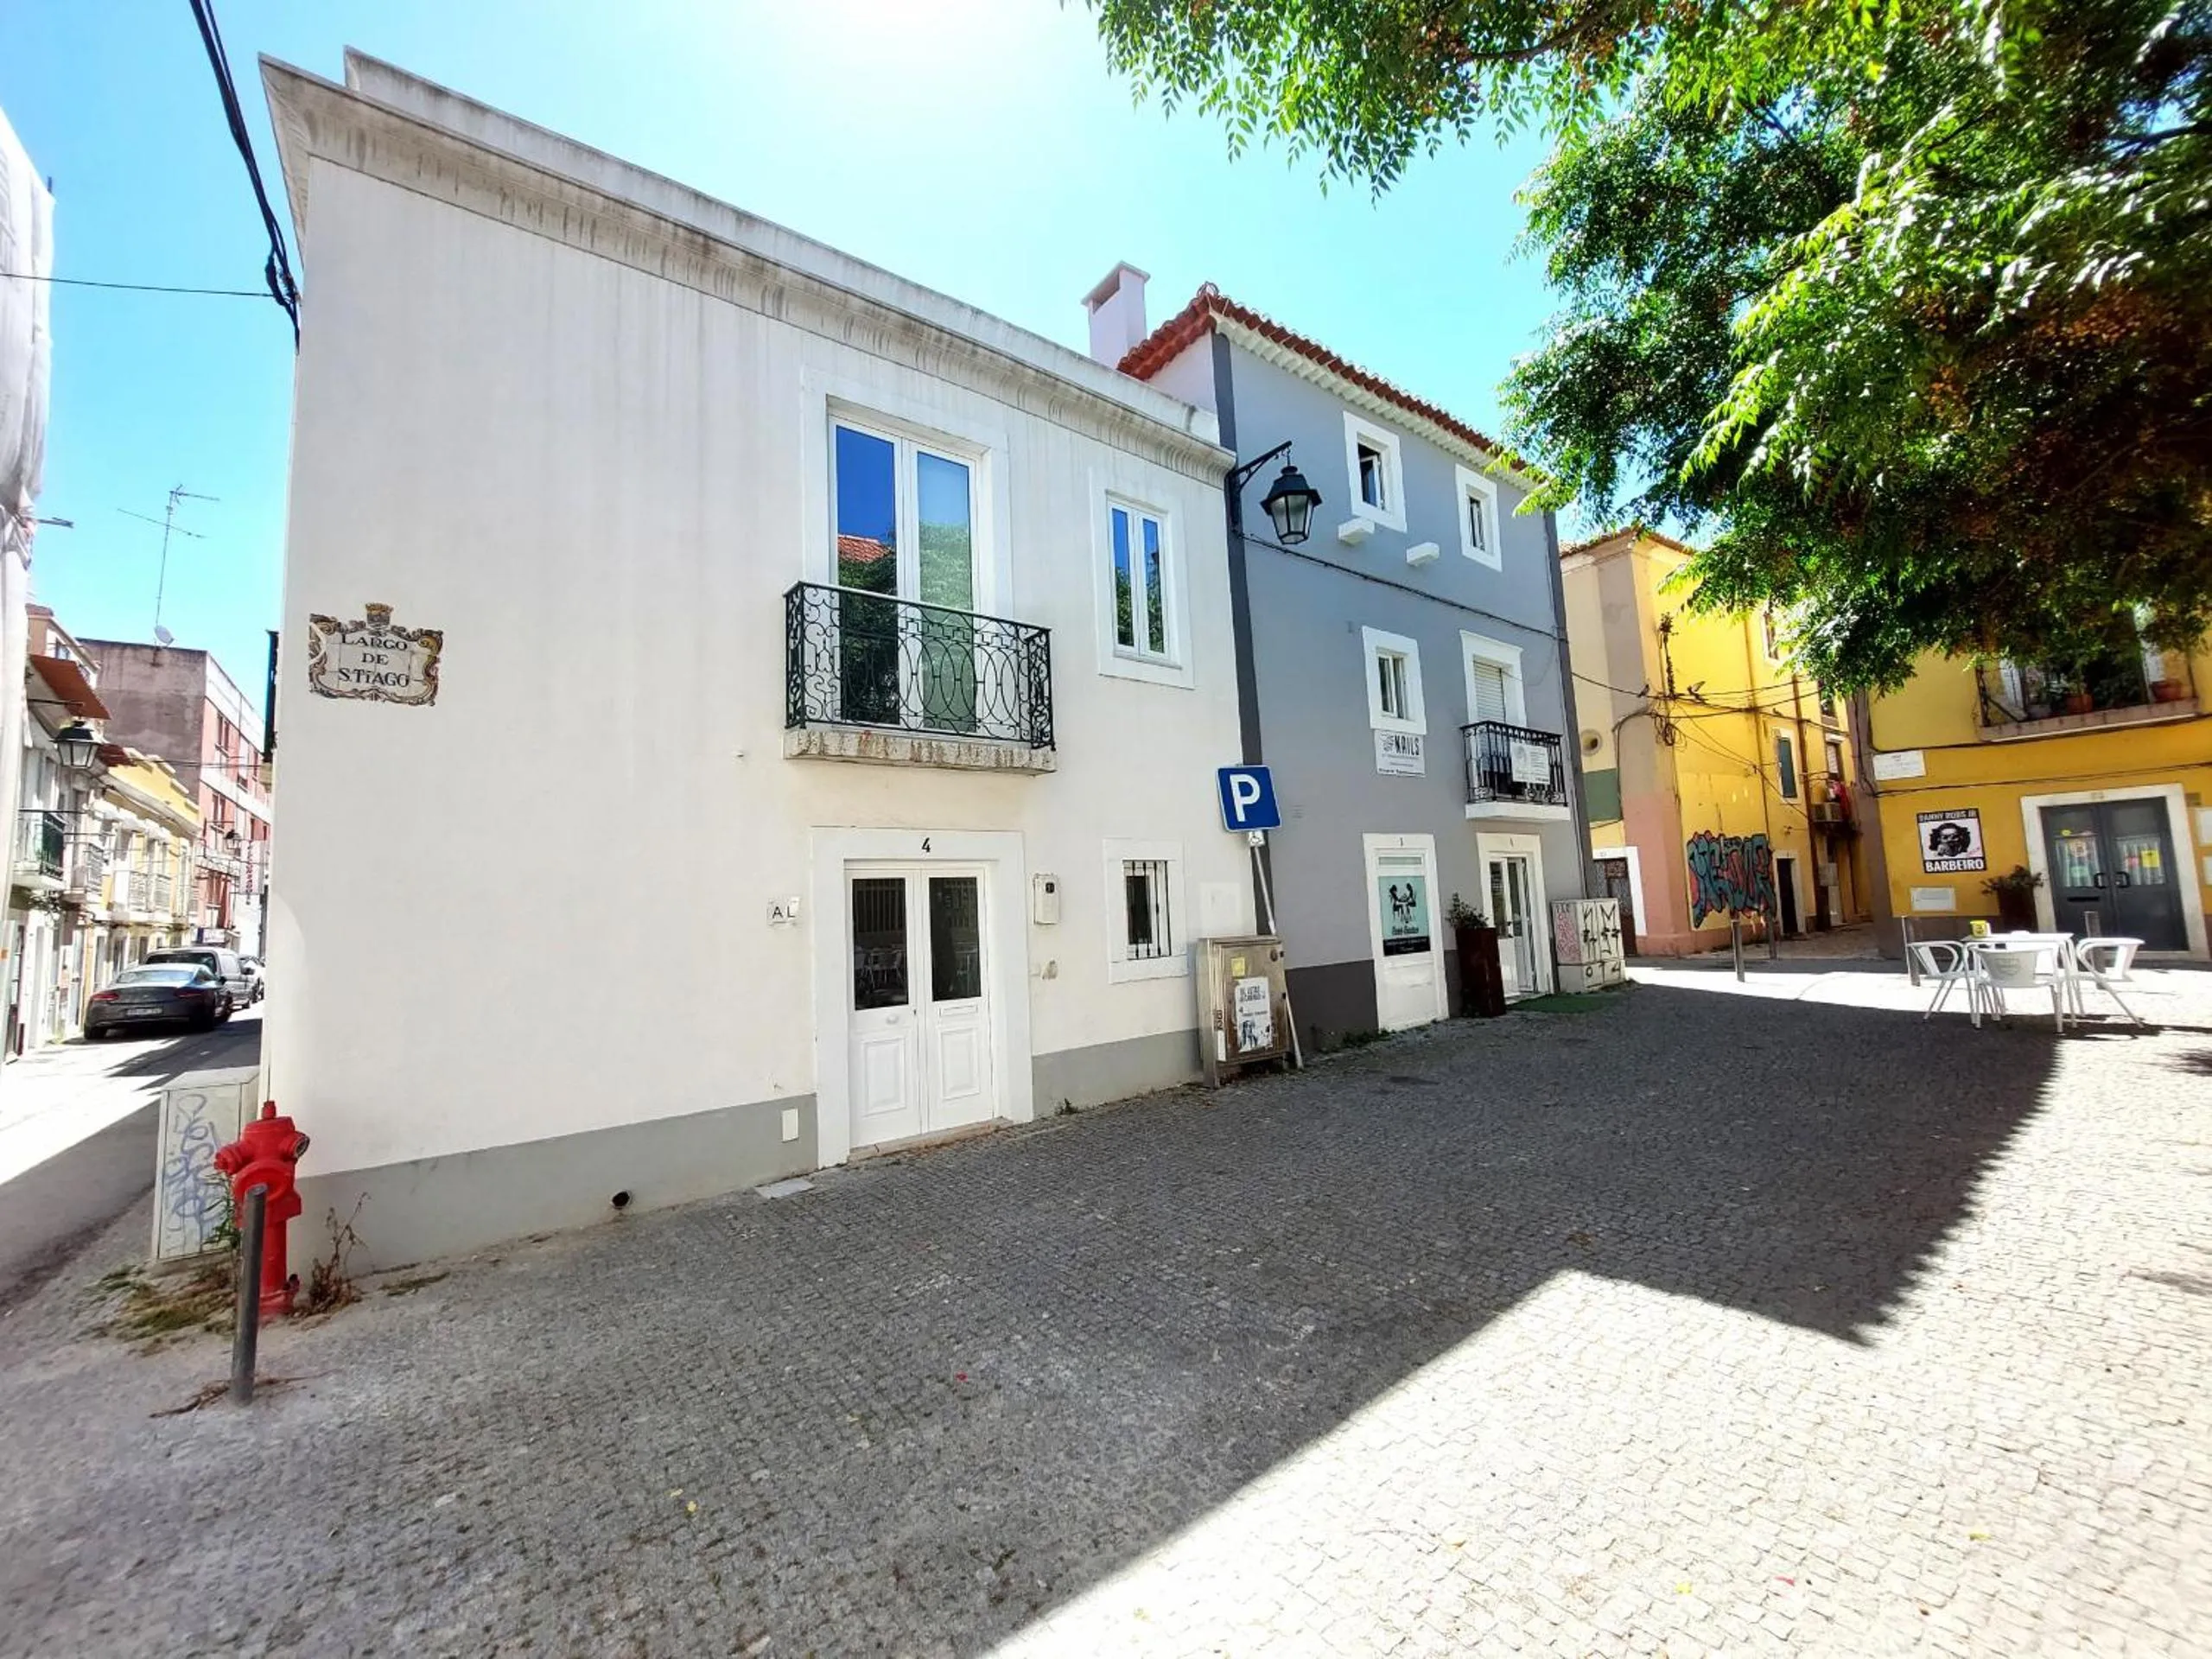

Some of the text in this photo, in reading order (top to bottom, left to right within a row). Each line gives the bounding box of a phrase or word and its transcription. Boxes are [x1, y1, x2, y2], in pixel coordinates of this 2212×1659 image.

[341, 634, 408, 651] LARGO
[362, 653, 389, 665] DE
[1230, 773, 1261, 823] P
[921, 836, 931, 853] 4
[1925, 858, 1985, 873] BARBEIRO
[772, 906, 796, 918] AL
